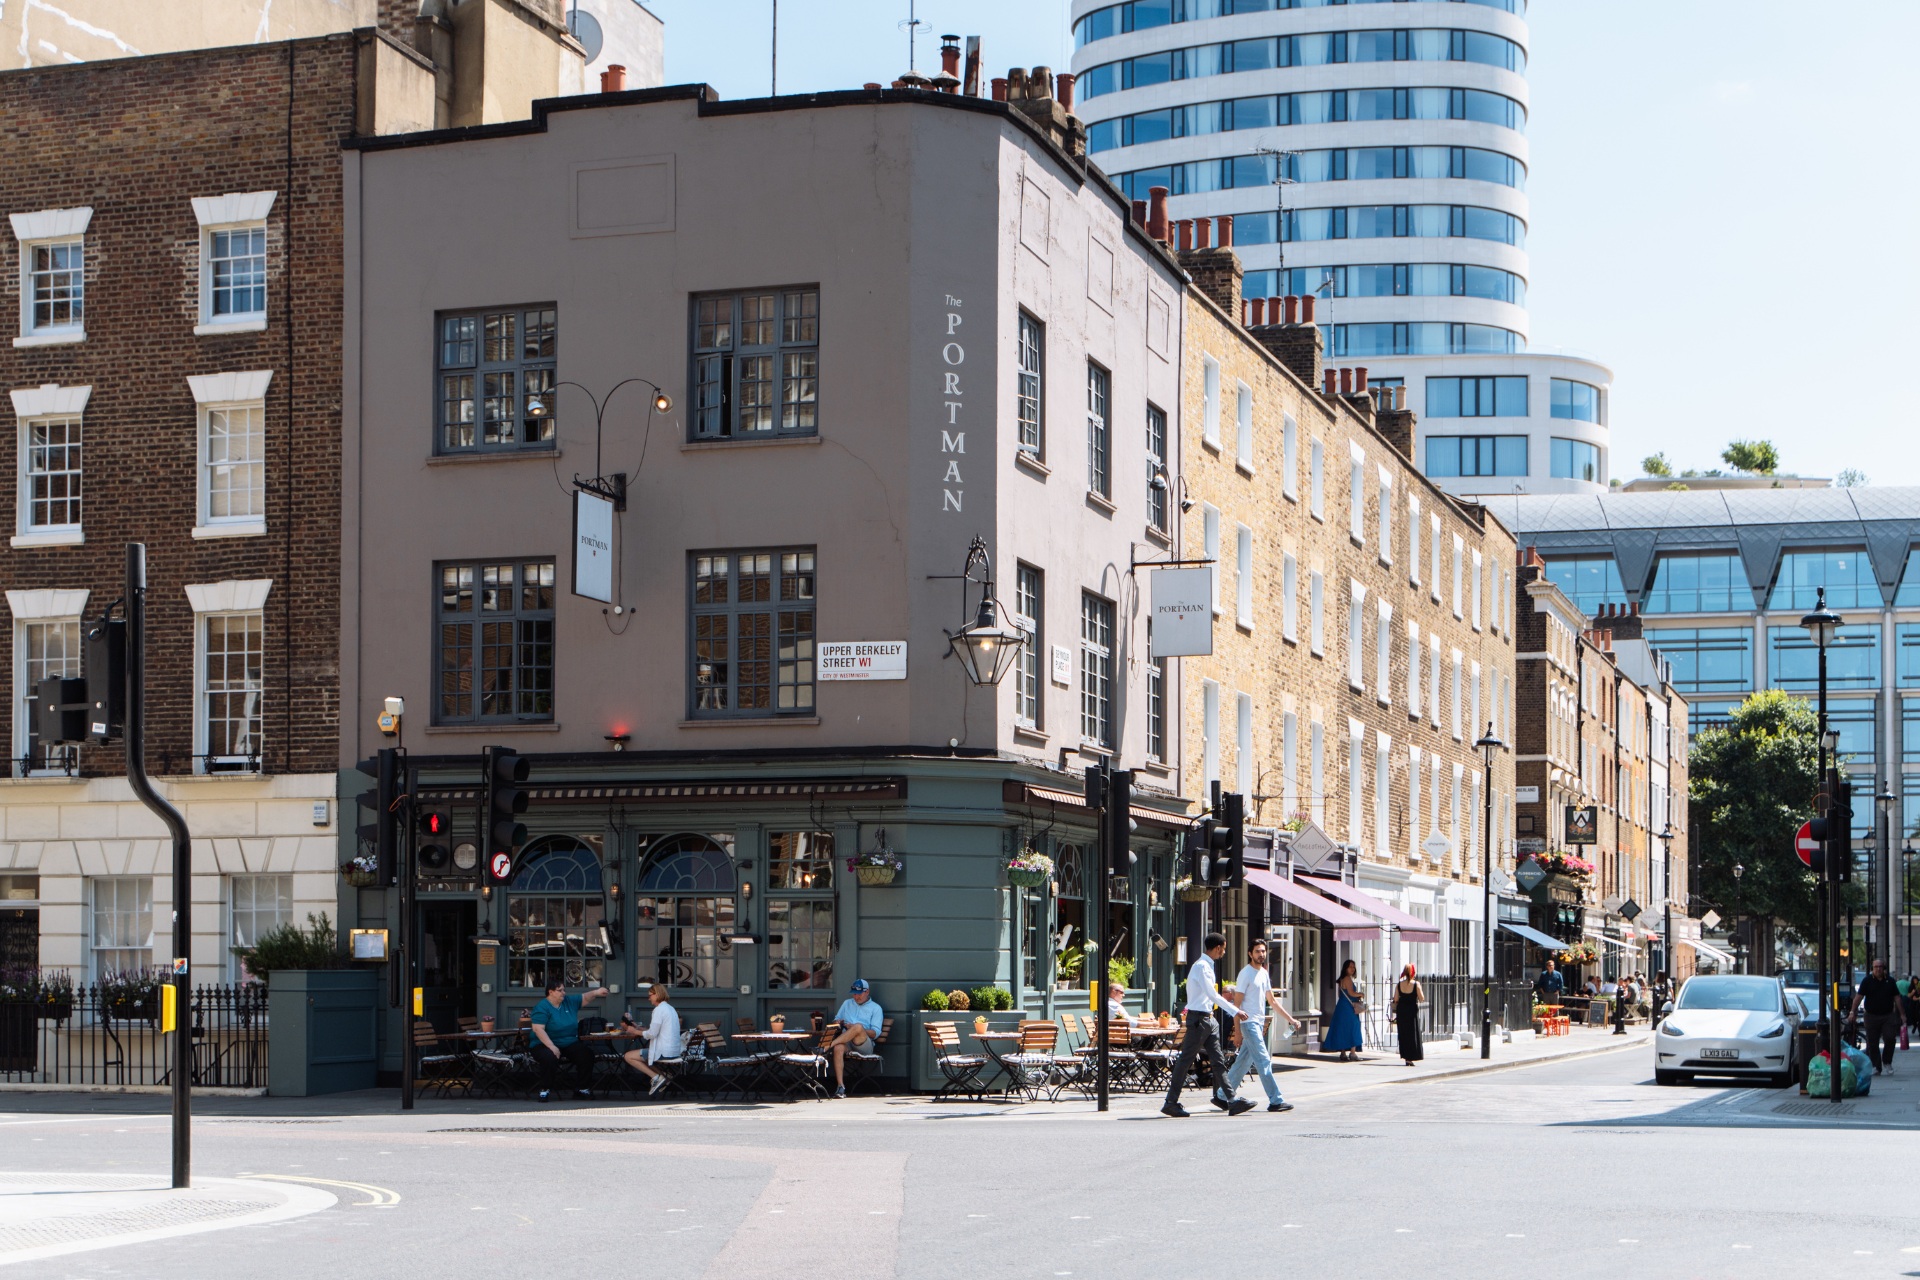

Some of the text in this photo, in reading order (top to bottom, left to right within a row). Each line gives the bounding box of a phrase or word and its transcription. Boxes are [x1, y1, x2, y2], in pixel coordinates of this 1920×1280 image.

[945, 294, 962, 307] The
[941, 313, 966, 512] PORTMAN
[581, 535, 608, 551] PORTMAN
[1159, 604, 1204, 613] PORTMAN
[823, 645, 901, 656] UPPER BERKELEY
[823, 657, 871, 668] STREET W1
